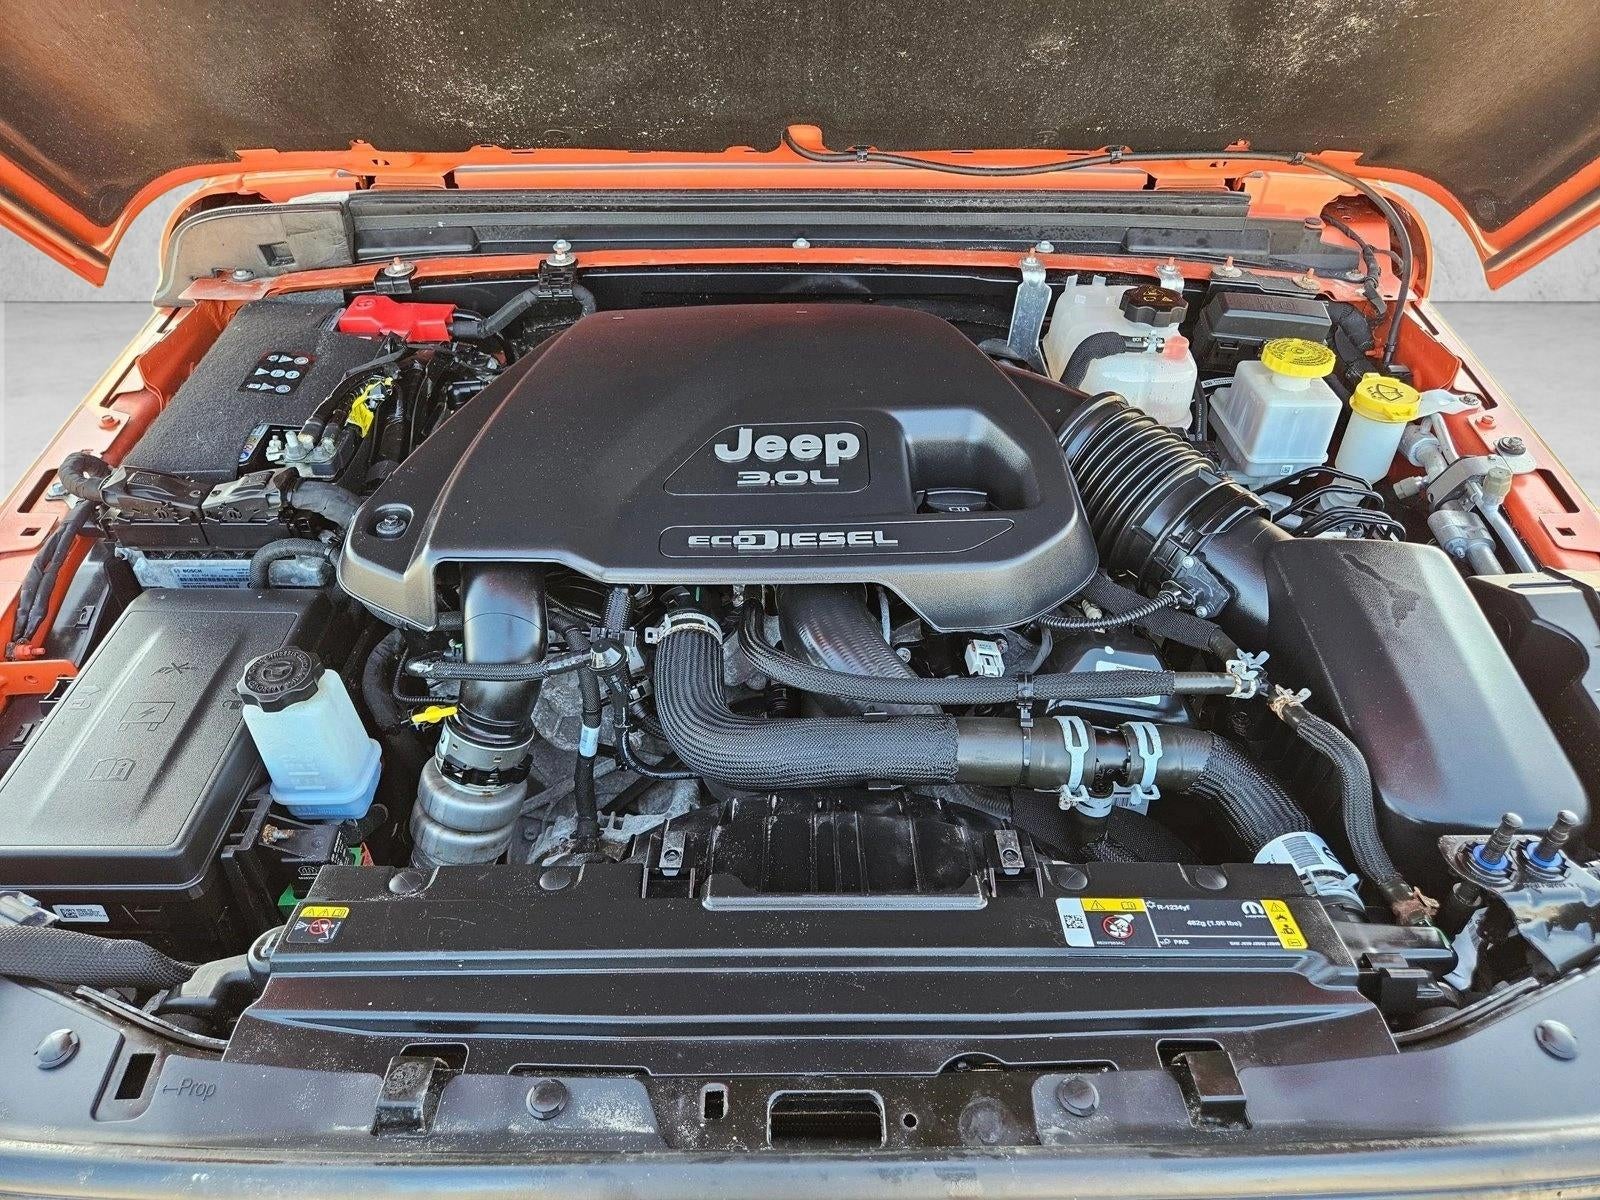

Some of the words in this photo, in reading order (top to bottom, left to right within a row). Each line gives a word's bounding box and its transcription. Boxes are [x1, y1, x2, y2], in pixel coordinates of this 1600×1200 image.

[714, 427, 860, 467] Jeep
[737, 470, 840, 486] 3.0L
[1156, 904, 1191, 912] R-1234yf
[177, 1078, 216, 1102] Prop
